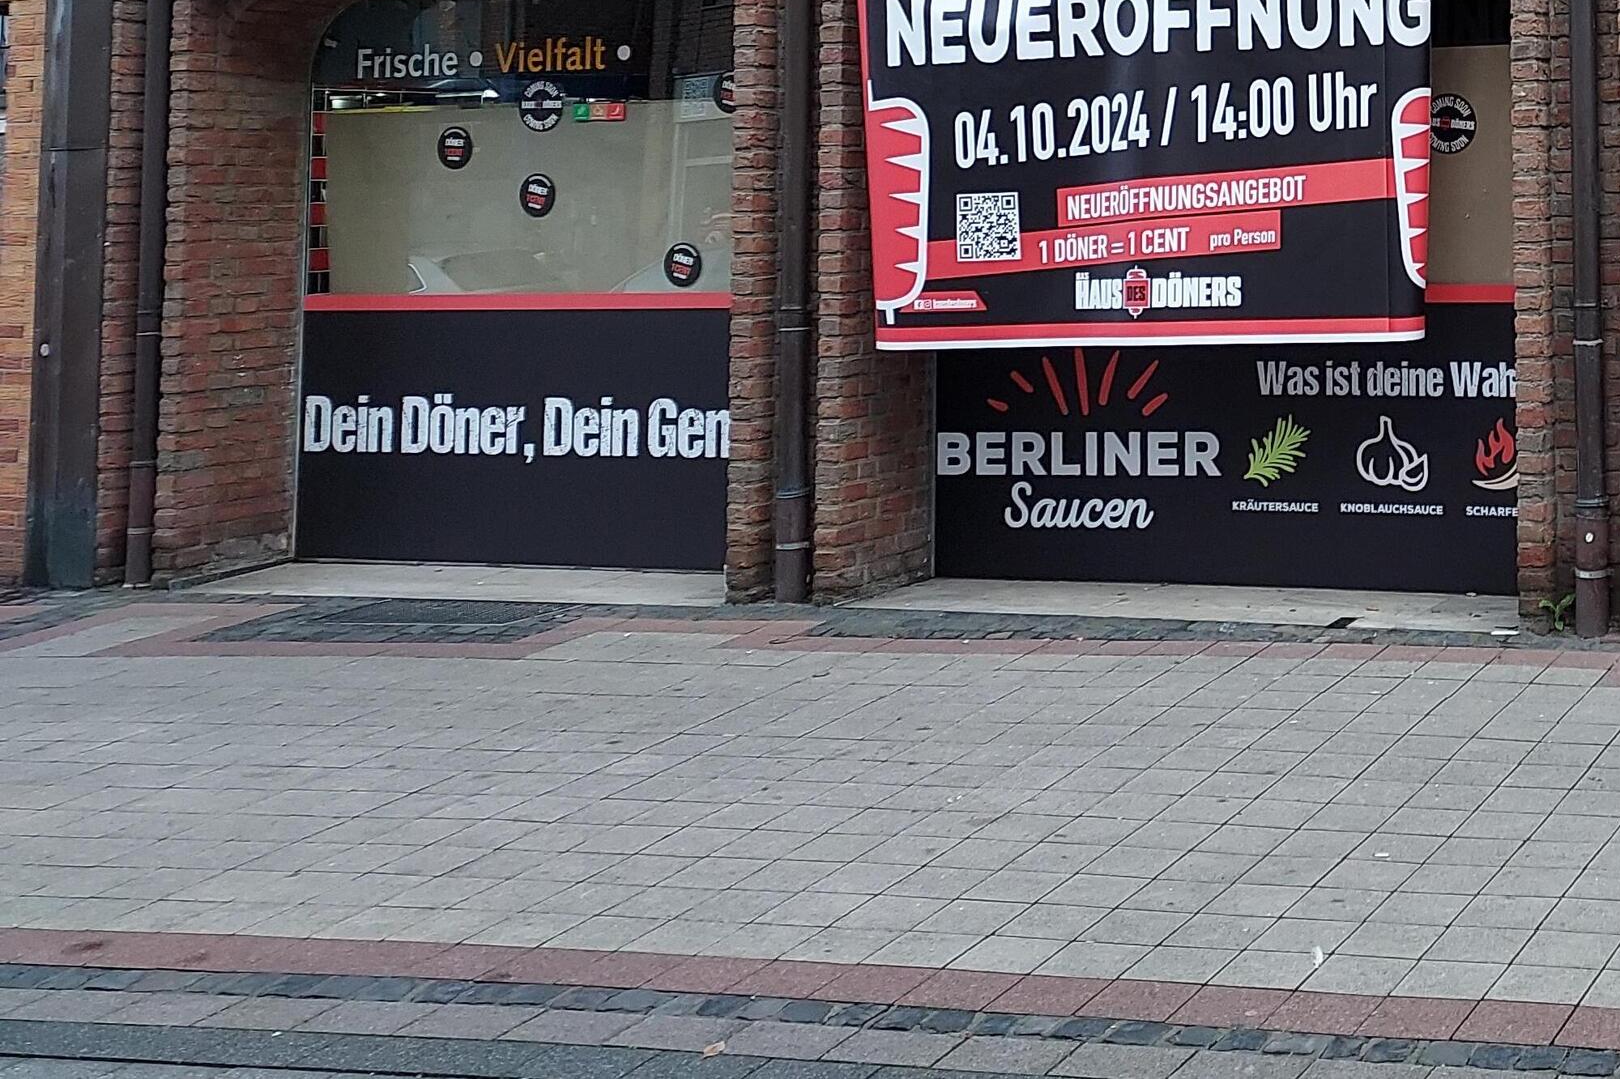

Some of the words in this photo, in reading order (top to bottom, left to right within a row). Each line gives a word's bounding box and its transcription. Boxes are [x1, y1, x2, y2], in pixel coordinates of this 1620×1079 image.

[357, 44, 459, 79] Frische
[495, 36, 607, 73] Vielfalt
[954, 89, 1150, 170] 04.10.2024
[1160, 86, 1179, 147] /
[1190, 76, 1293, 145] 14:00
[1307, 71, 1378, 130] Uhr
[1067, 175, 1307, 221] NEUERÖFFNUNGSANGEBOT
[1038, 241, 1048, 264] 1
[1054, 233, 1108, 263] DÖNER
[1128, 231, 1136, 255] 1
[1141, 227, 1190, 254] CENT
[1209, 232, 1231, 251] pro
[1233, 228, 1276, 245] Person
[1075, 278, 1123, 310] HAUS
[1126, 286, 1146, 302] DES
[1151, 272, 1242, 308] DÖNERS
[1256, 360, 1319, 396] Was
[1325, 360, 1360, 396] ist
[1366, 361, 1444, 397] deine
[303, 395, 393, 454] Dein
[400, 393, 535, 464] Döner,
[542, 396, 639, 458] Dein
[937, 431, 1222, 477] BERLINER
[1004, 480, 1155, 529] Saucen
[1232, 499, 1319, 513] KRÄUTERSAUCE
[1340, 502, 1444, 516] KNOBLAUCHSAUCE
